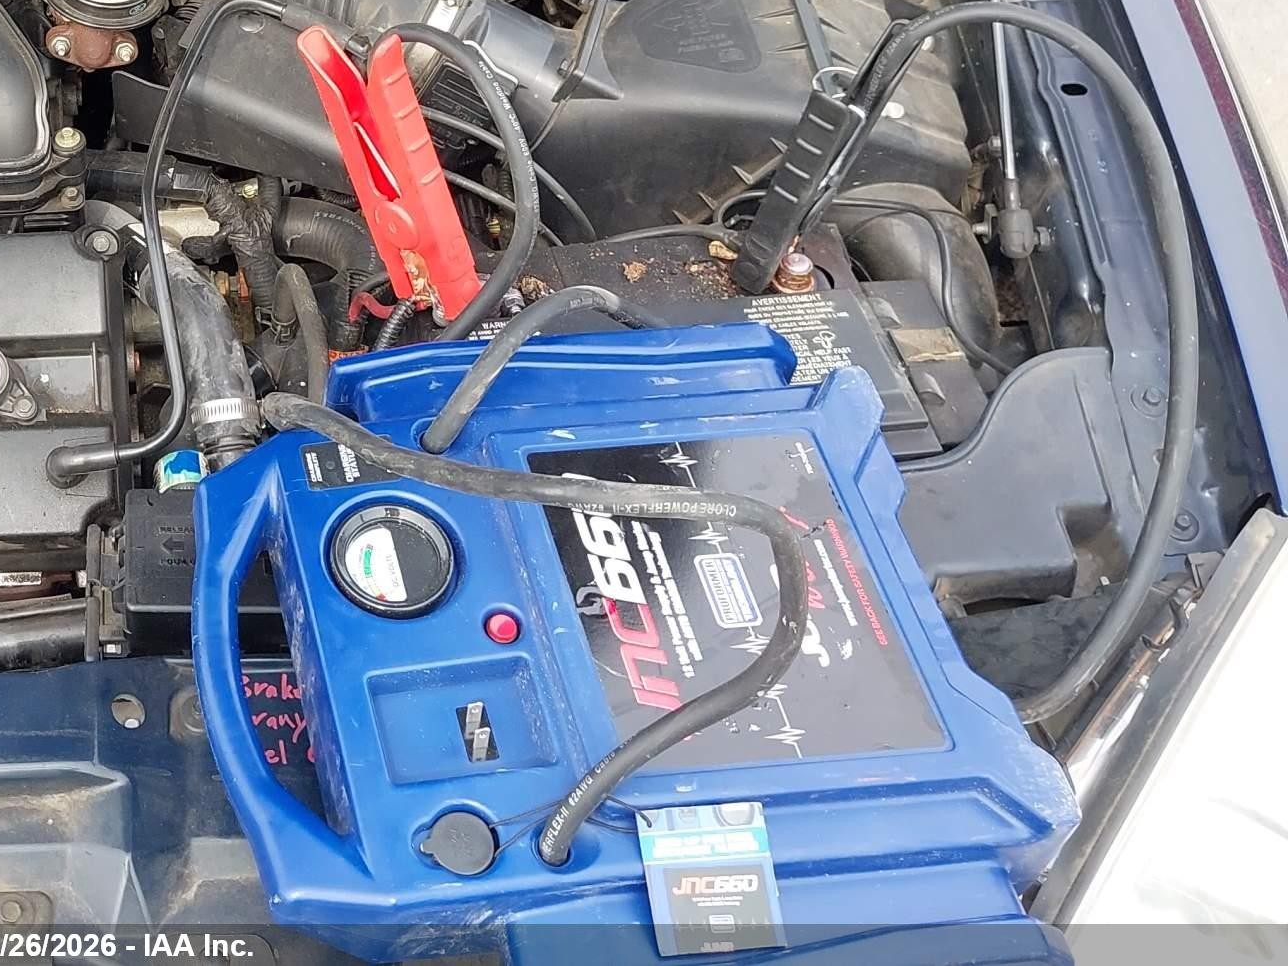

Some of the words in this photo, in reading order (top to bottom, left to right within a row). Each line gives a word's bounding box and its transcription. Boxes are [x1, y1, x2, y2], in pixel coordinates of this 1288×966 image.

[492, 81, 511, 111] Welding
[481, 321, 510, 330] WARN
[700, 503, 737, 517] CLORE
[844, 557, 862, 590] SAFETY
[672, 874, 758, 896] JNC660
